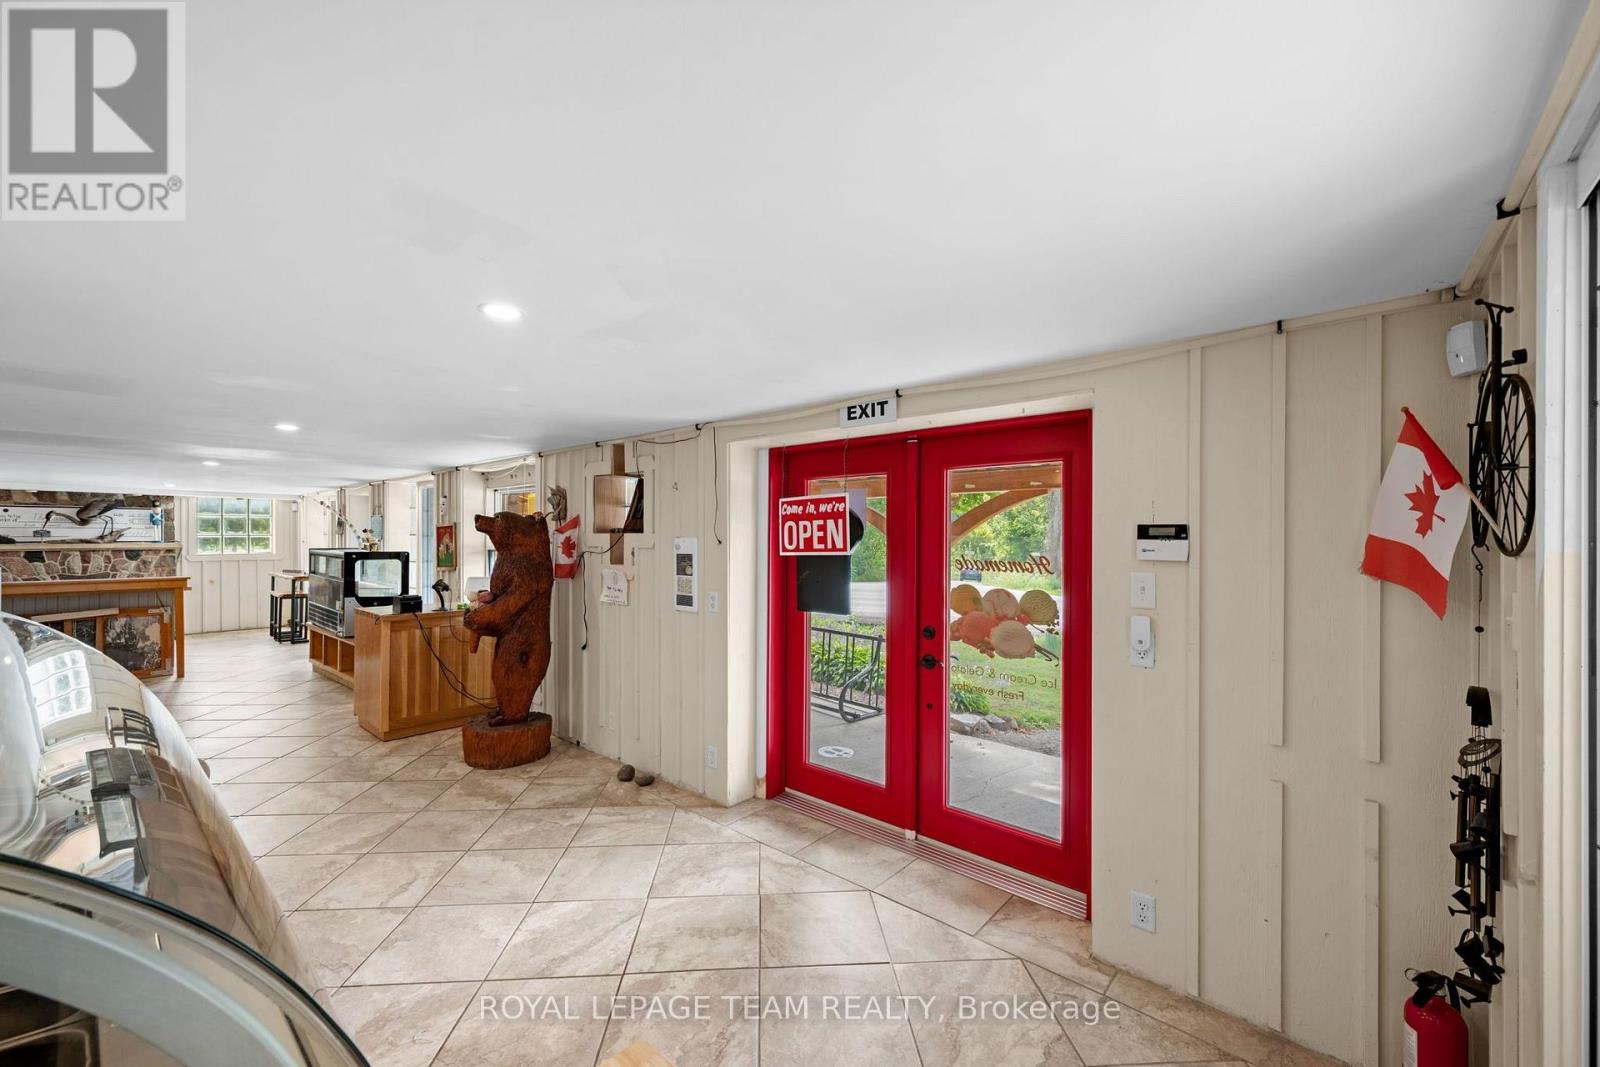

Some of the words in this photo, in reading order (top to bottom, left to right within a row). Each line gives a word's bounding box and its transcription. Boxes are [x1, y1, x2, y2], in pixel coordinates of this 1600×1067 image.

[847, 400, 889, 421] EXIT
[781, 503, 803, 515] Come
[805, 502, 817, 515] in,
[819, 501, 846, 513] we're
[783, 518, 844, 550] OPEN
